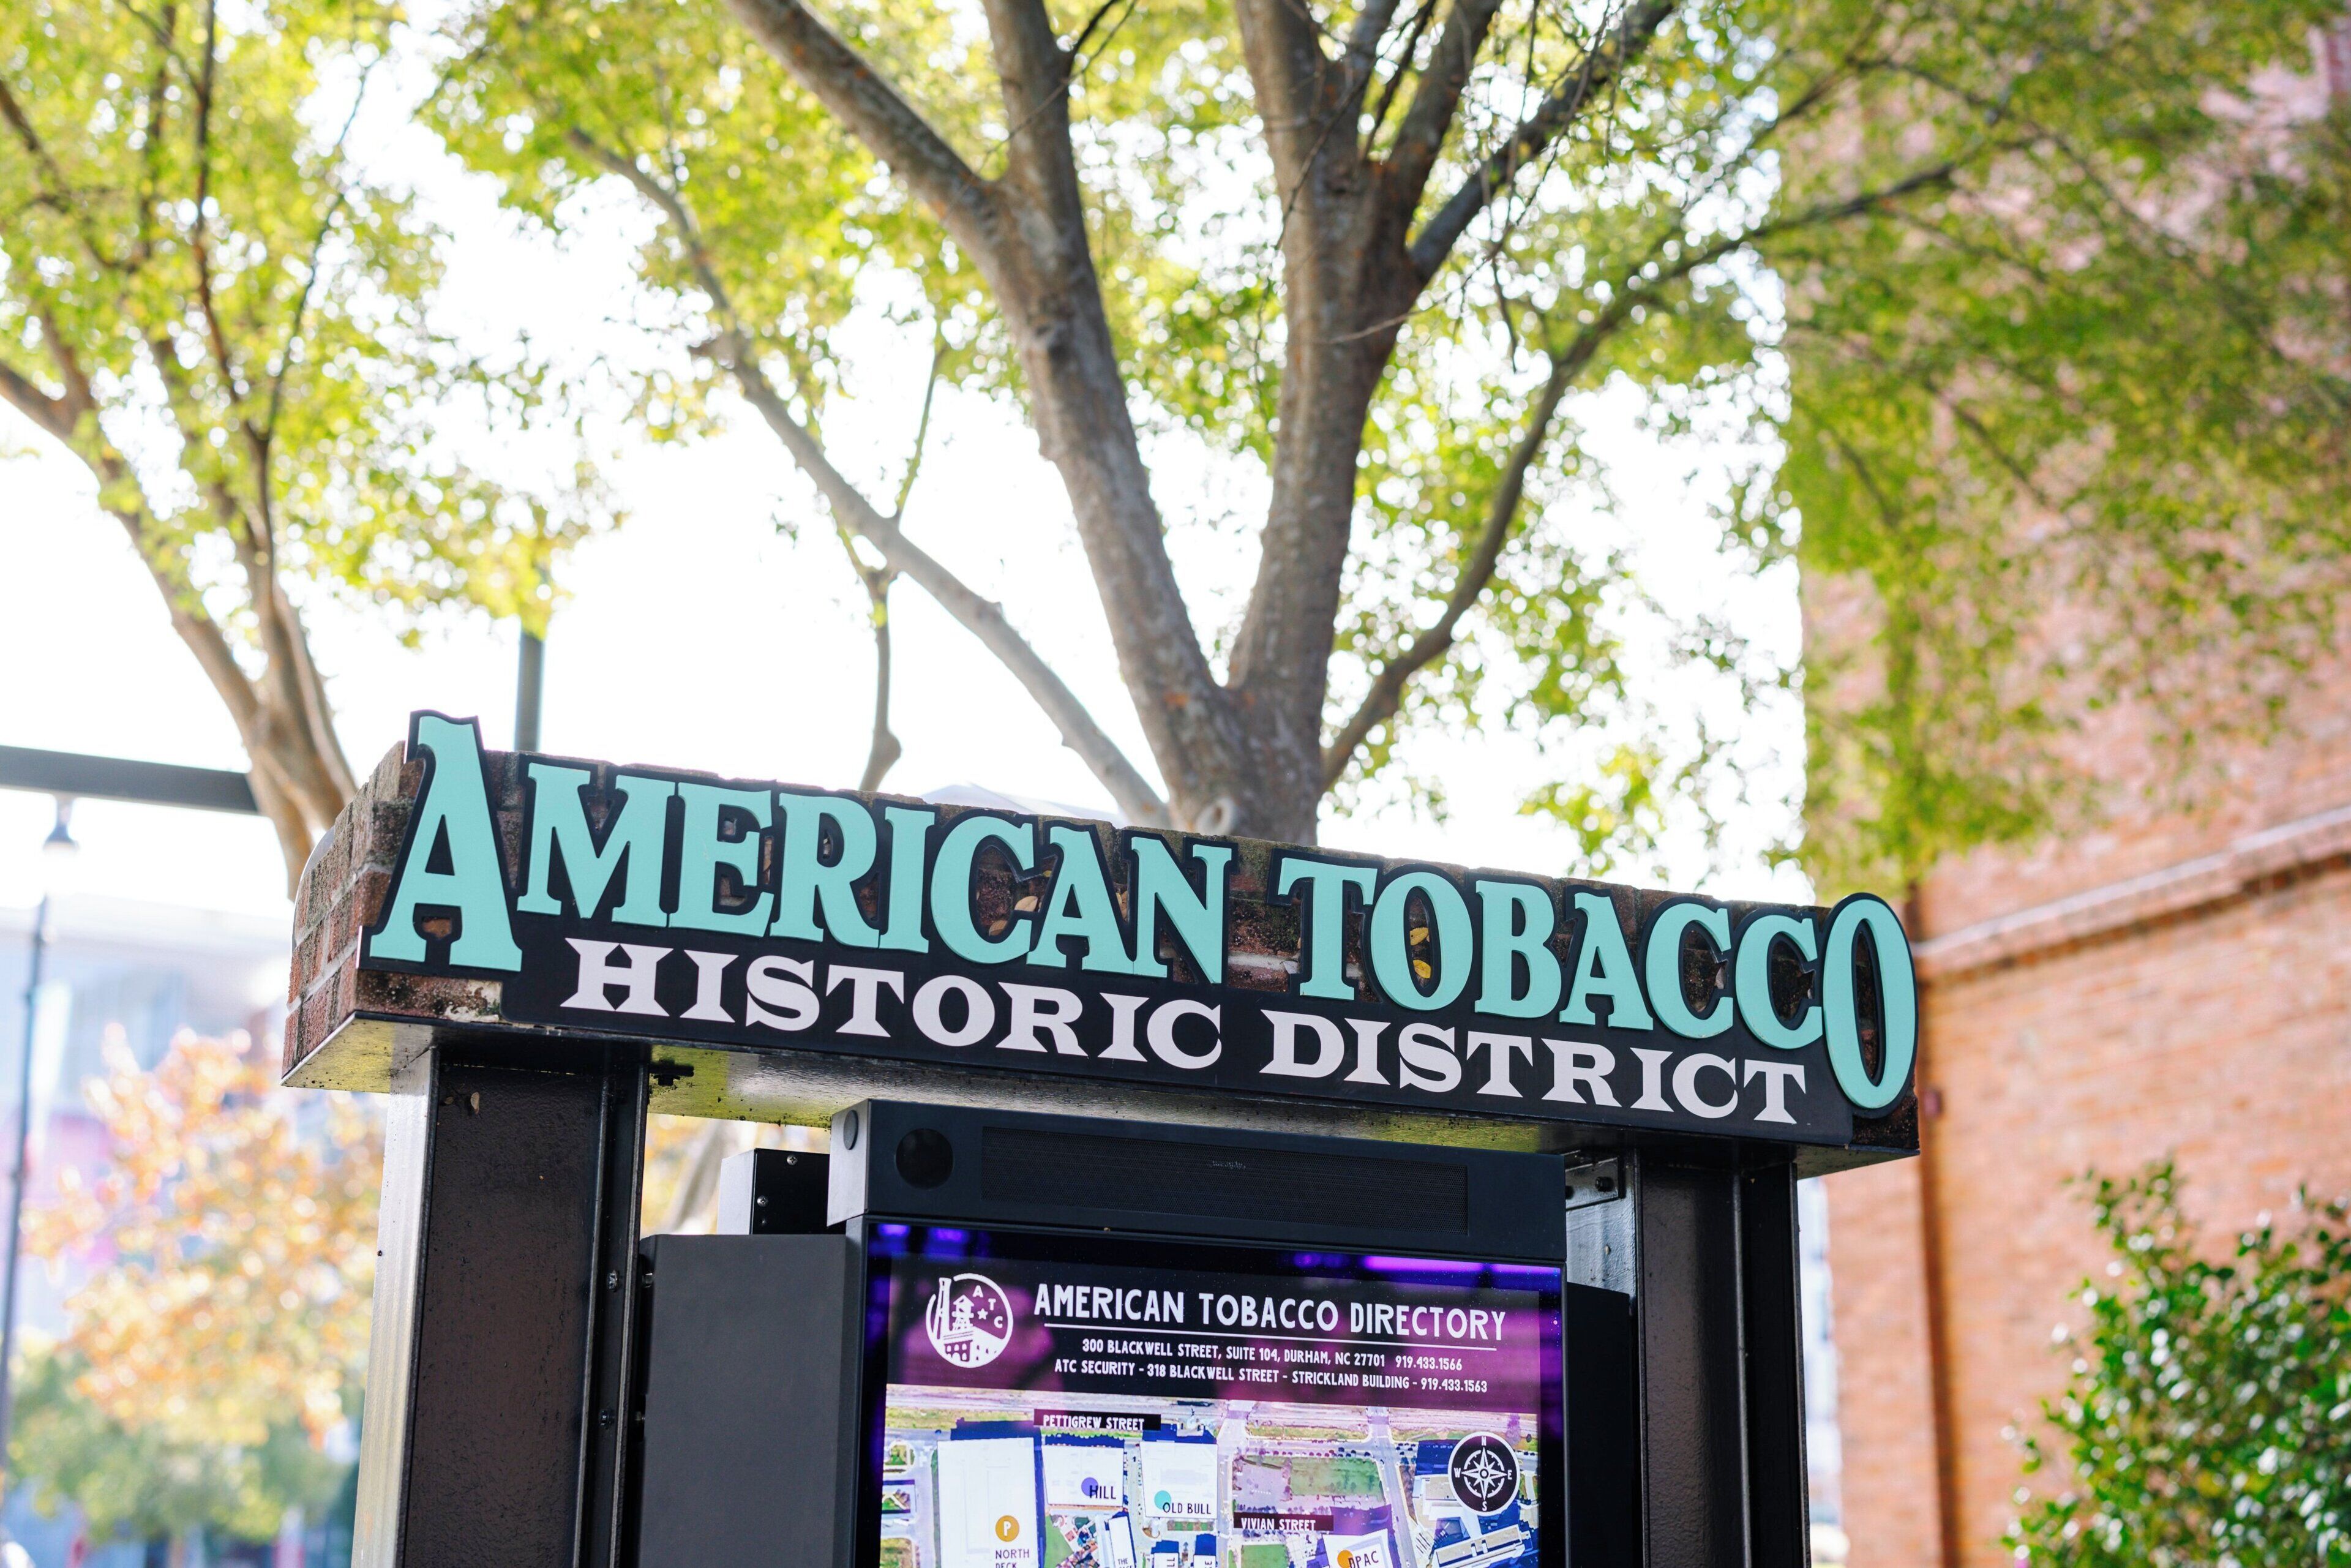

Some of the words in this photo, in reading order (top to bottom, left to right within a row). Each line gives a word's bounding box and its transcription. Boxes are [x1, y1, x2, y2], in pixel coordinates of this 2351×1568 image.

[369, 714, 1232, 984] AMERICAN
[1277, 857, 1917, 1109] TOBACCO
[560, 937, 1222, 1070] HISTORIC
[1259, 1008, 1807, 1124] DISTRICT
[1033, 1283, 1184, 1324] AMERICAN
[1199, 1292, 1338, 1332] TOBACCO
[1351, 1302, 1505, 1341] DIRECTORY
[1082, 1338, 1104, 1352] 300
[1107, 1340, 1173, 1357] BLACKWELL
[1177, 1343, 1221, 1360] STREET,
[1226, 1347, 1256, 1361] SUITE
[1259, 1348, 1281, 1363] 104,
[1284, 1349, 1331, 1365] DURHAM,
[1335, 1352, 1351, 1366] NC
[1354, 1353, 1385, 1368] 27701
[1395, 1356, 1463, 1371] 919.433.1566
[1054, 1359, 1077, 1373] ATC
[1081, 1360, 1136, 1376] SECURITY
[1147, 1365, 1166, 1378] 318
[1169, 1365, 1234, 1381] BLACKWELL
[1239, 1368, 1279, 1383] STREET
[1292, 1370, 1359, 1387] STRICKLAND
[1362, 1373, 1409, 1389] BUILDING
[1421, 1378, 1488, 1393] 919.433.1563
[1043, 1414, 1102, 1430] PETTIGREW
[1106, 1418, 1145, 1431] STREET
[1481, 1436, 1487, 1446] N
[1453, 1468, 1461, 1478] W
[1507, 1469, 1512, 1480] E
[1089, 1485, 1117, 1499] HILL
[1163, 1502, 1183, 1514] OLD
[1187, 1503, 1212, 1515] BULL
[1482, 1501, 1487, 1512] S
[1003, 1521, 1011, 1537] P
[1241, 1517, 1275, 1531] VIVIAN
[1279, 1518, 1316, 1531] STREET
[995, 1548, 1030, 1559] NORTH
[1348, 1550, 1379, 1568] DPAC
